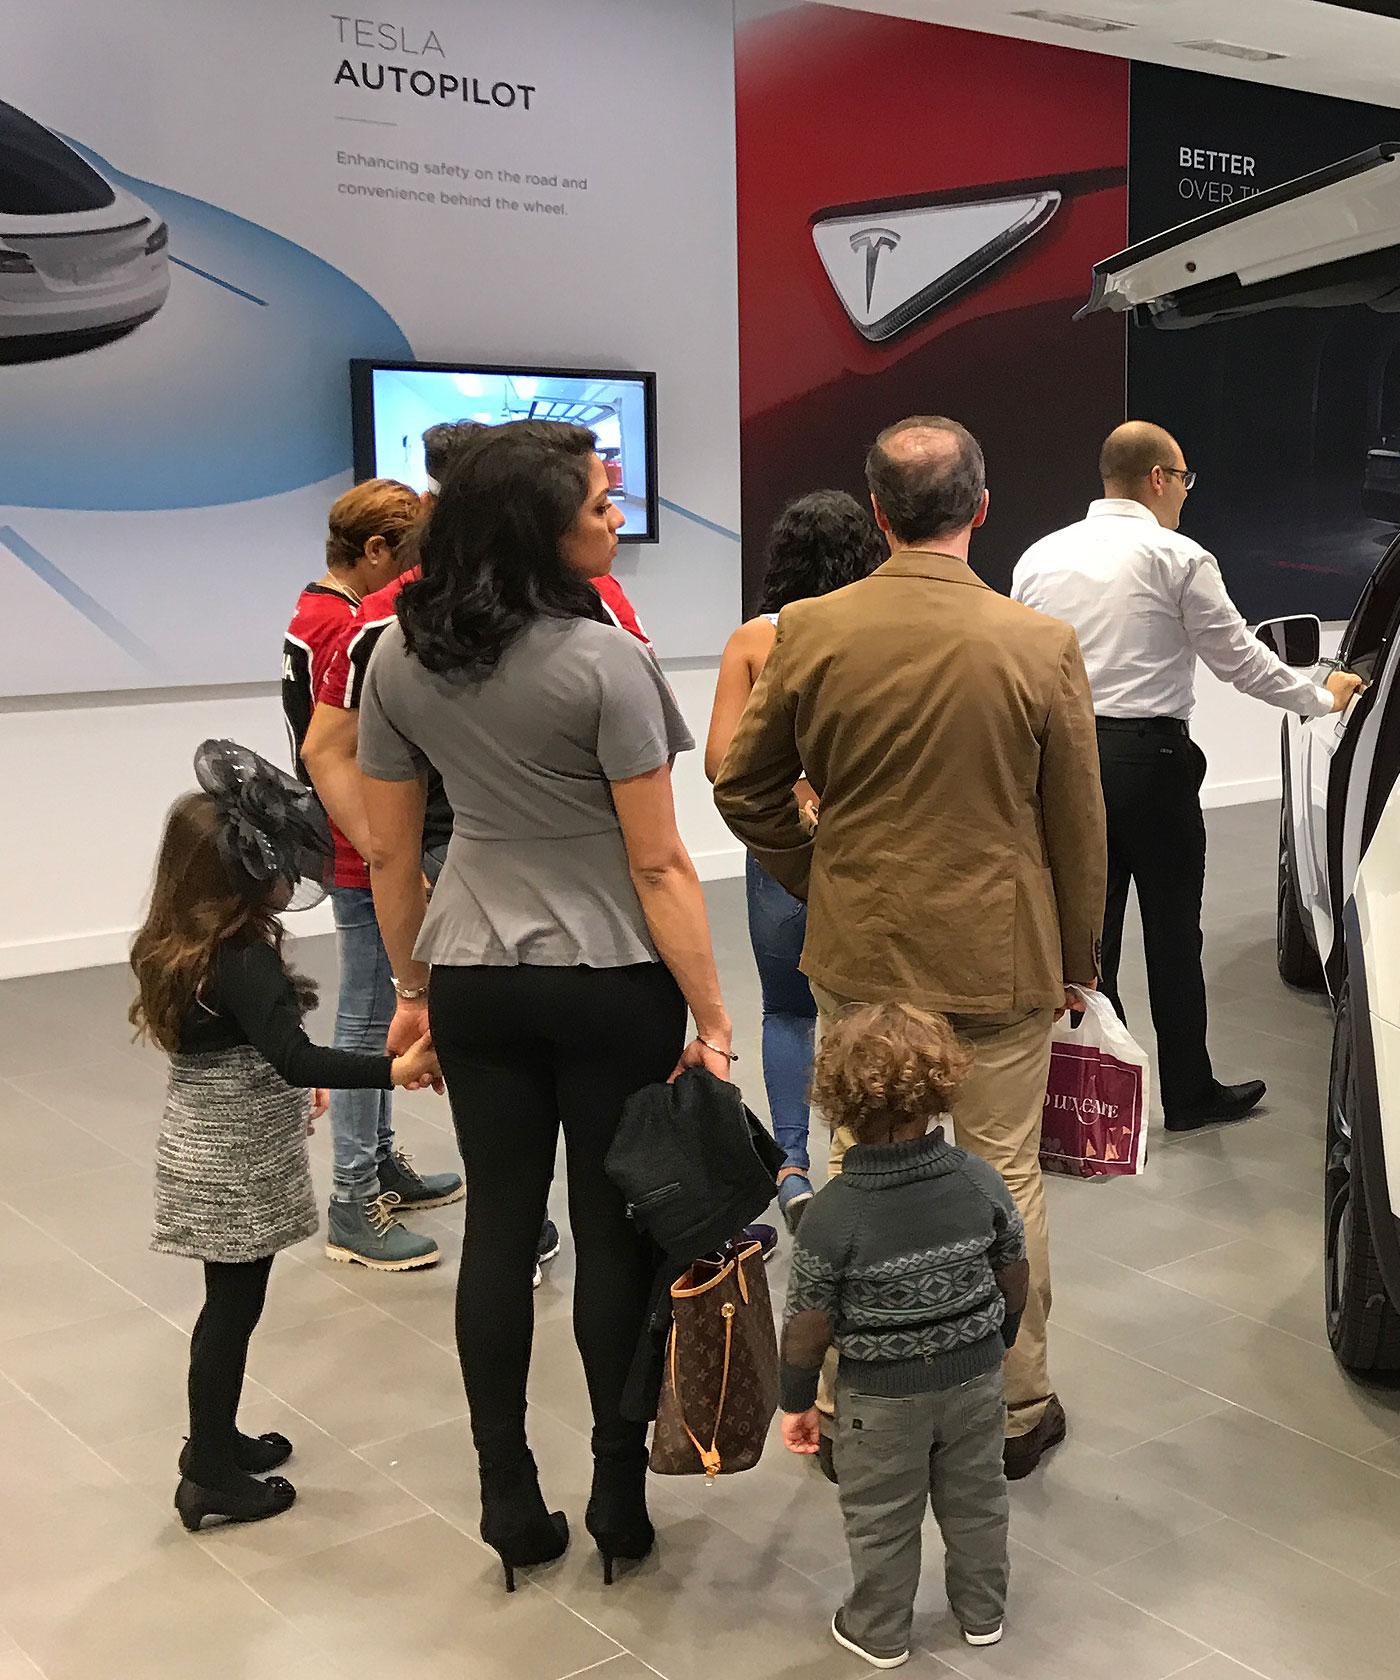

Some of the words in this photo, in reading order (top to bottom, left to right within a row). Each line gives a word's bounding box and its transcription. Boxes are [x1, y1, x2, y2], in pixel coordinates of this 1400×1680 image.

[330, 14, 446, 58] TESLA
[333, 59, 536, 111] AUTOPILOT
[336, 150, 419, 175] Enhancing
[424, 161, 470, 180] safety
[474, 169, 494, 181] on
[498, 169, 521, 184] the
[525, 172, 558, 188] road
[561, 176, 588, 190] and
[1179, 146, 1255, 177] BETTER
[337, 182, 435, 204] convenience
[440, 191, 491, 209] behind
[496, 195, 519, 212] the
[523, 200, 569, 216] wheel.
[1178, 177, 1234, 204] OVER
